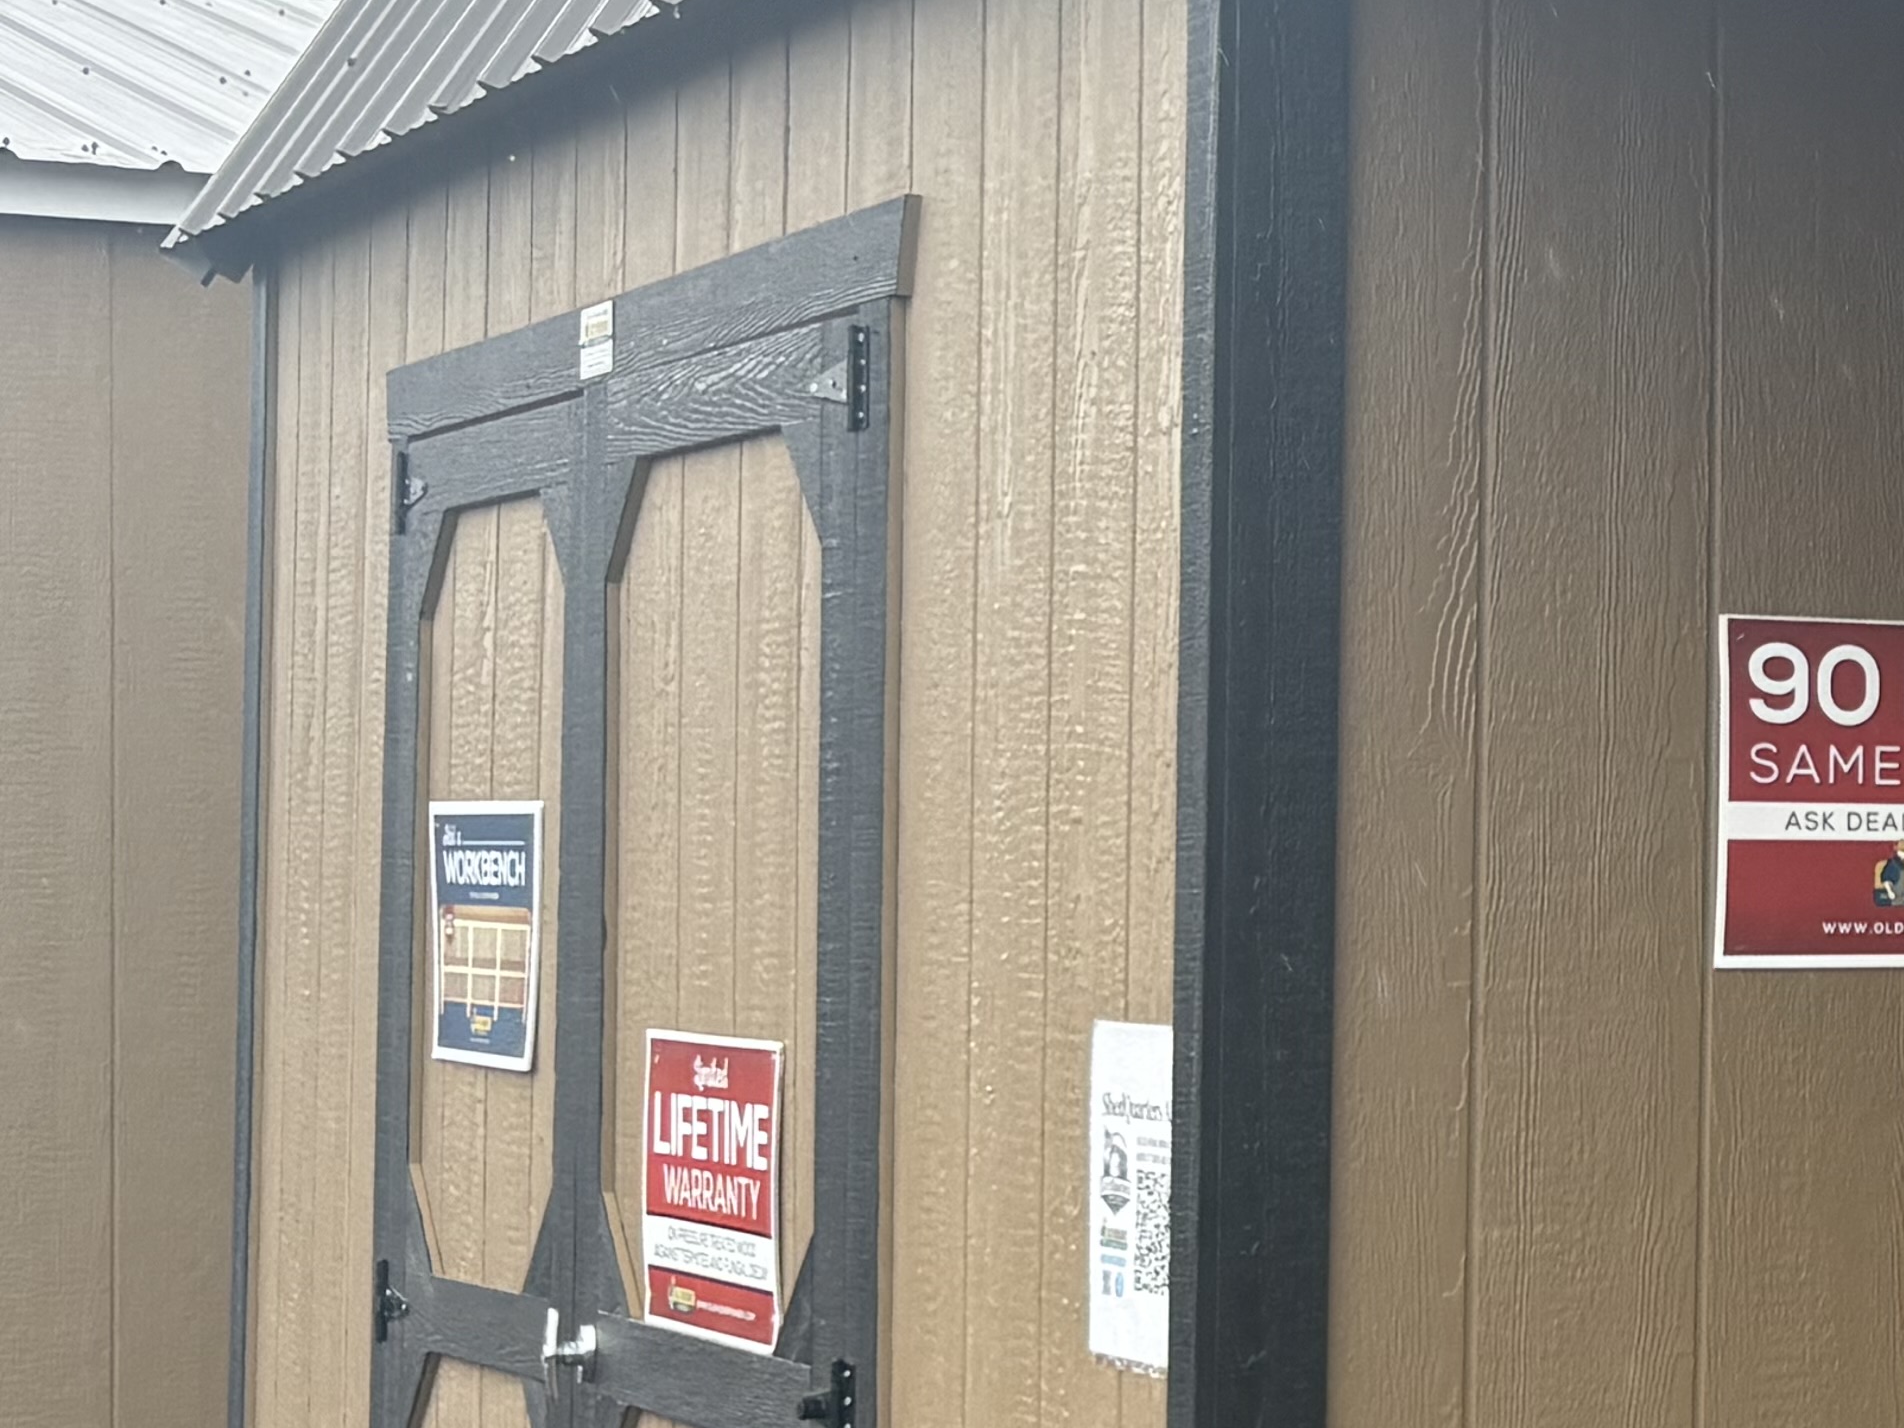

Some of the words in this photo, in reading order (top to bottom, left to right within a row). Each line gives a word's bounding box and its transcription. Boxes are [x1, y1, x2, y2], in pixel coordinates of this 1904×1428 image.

[1748, 643, 1880, 726] 90
[1750, 744, 1902, 786] SAME
[1785, 811, 1836, 832] ASK
[443, 850, 525, 886] WORKBENCH
[653, 1091, 770, 1171] LIFETIME
[663, 1164, 761, 1220] WARRANTY
